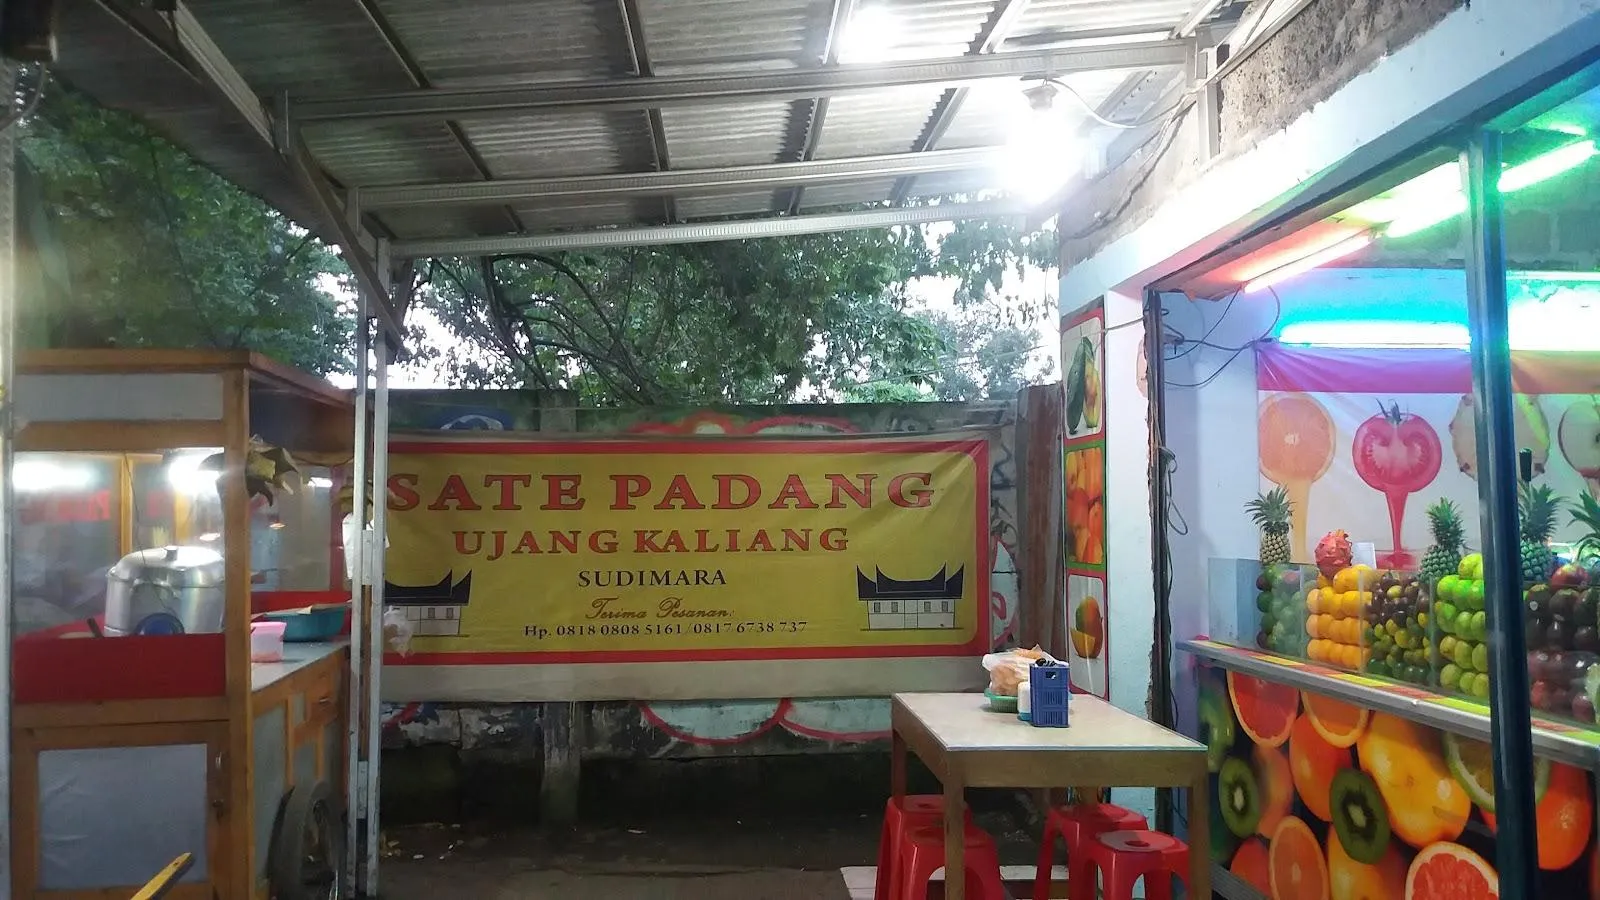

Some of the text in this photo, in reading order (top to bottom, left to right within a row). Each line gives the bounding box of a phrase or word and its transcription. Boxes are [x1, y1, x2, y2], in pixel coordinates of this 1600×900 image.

[386, 472, 935, 511] SATE PADANG
[452, 527, 849, 561] UJANG KALIANG
[577, 569, 727, 588] SUDIMARA
[585, 596, 648, 619] Terima
[556, 625, 597, 636] 0818
[600, 624, 640, 636] 0808
